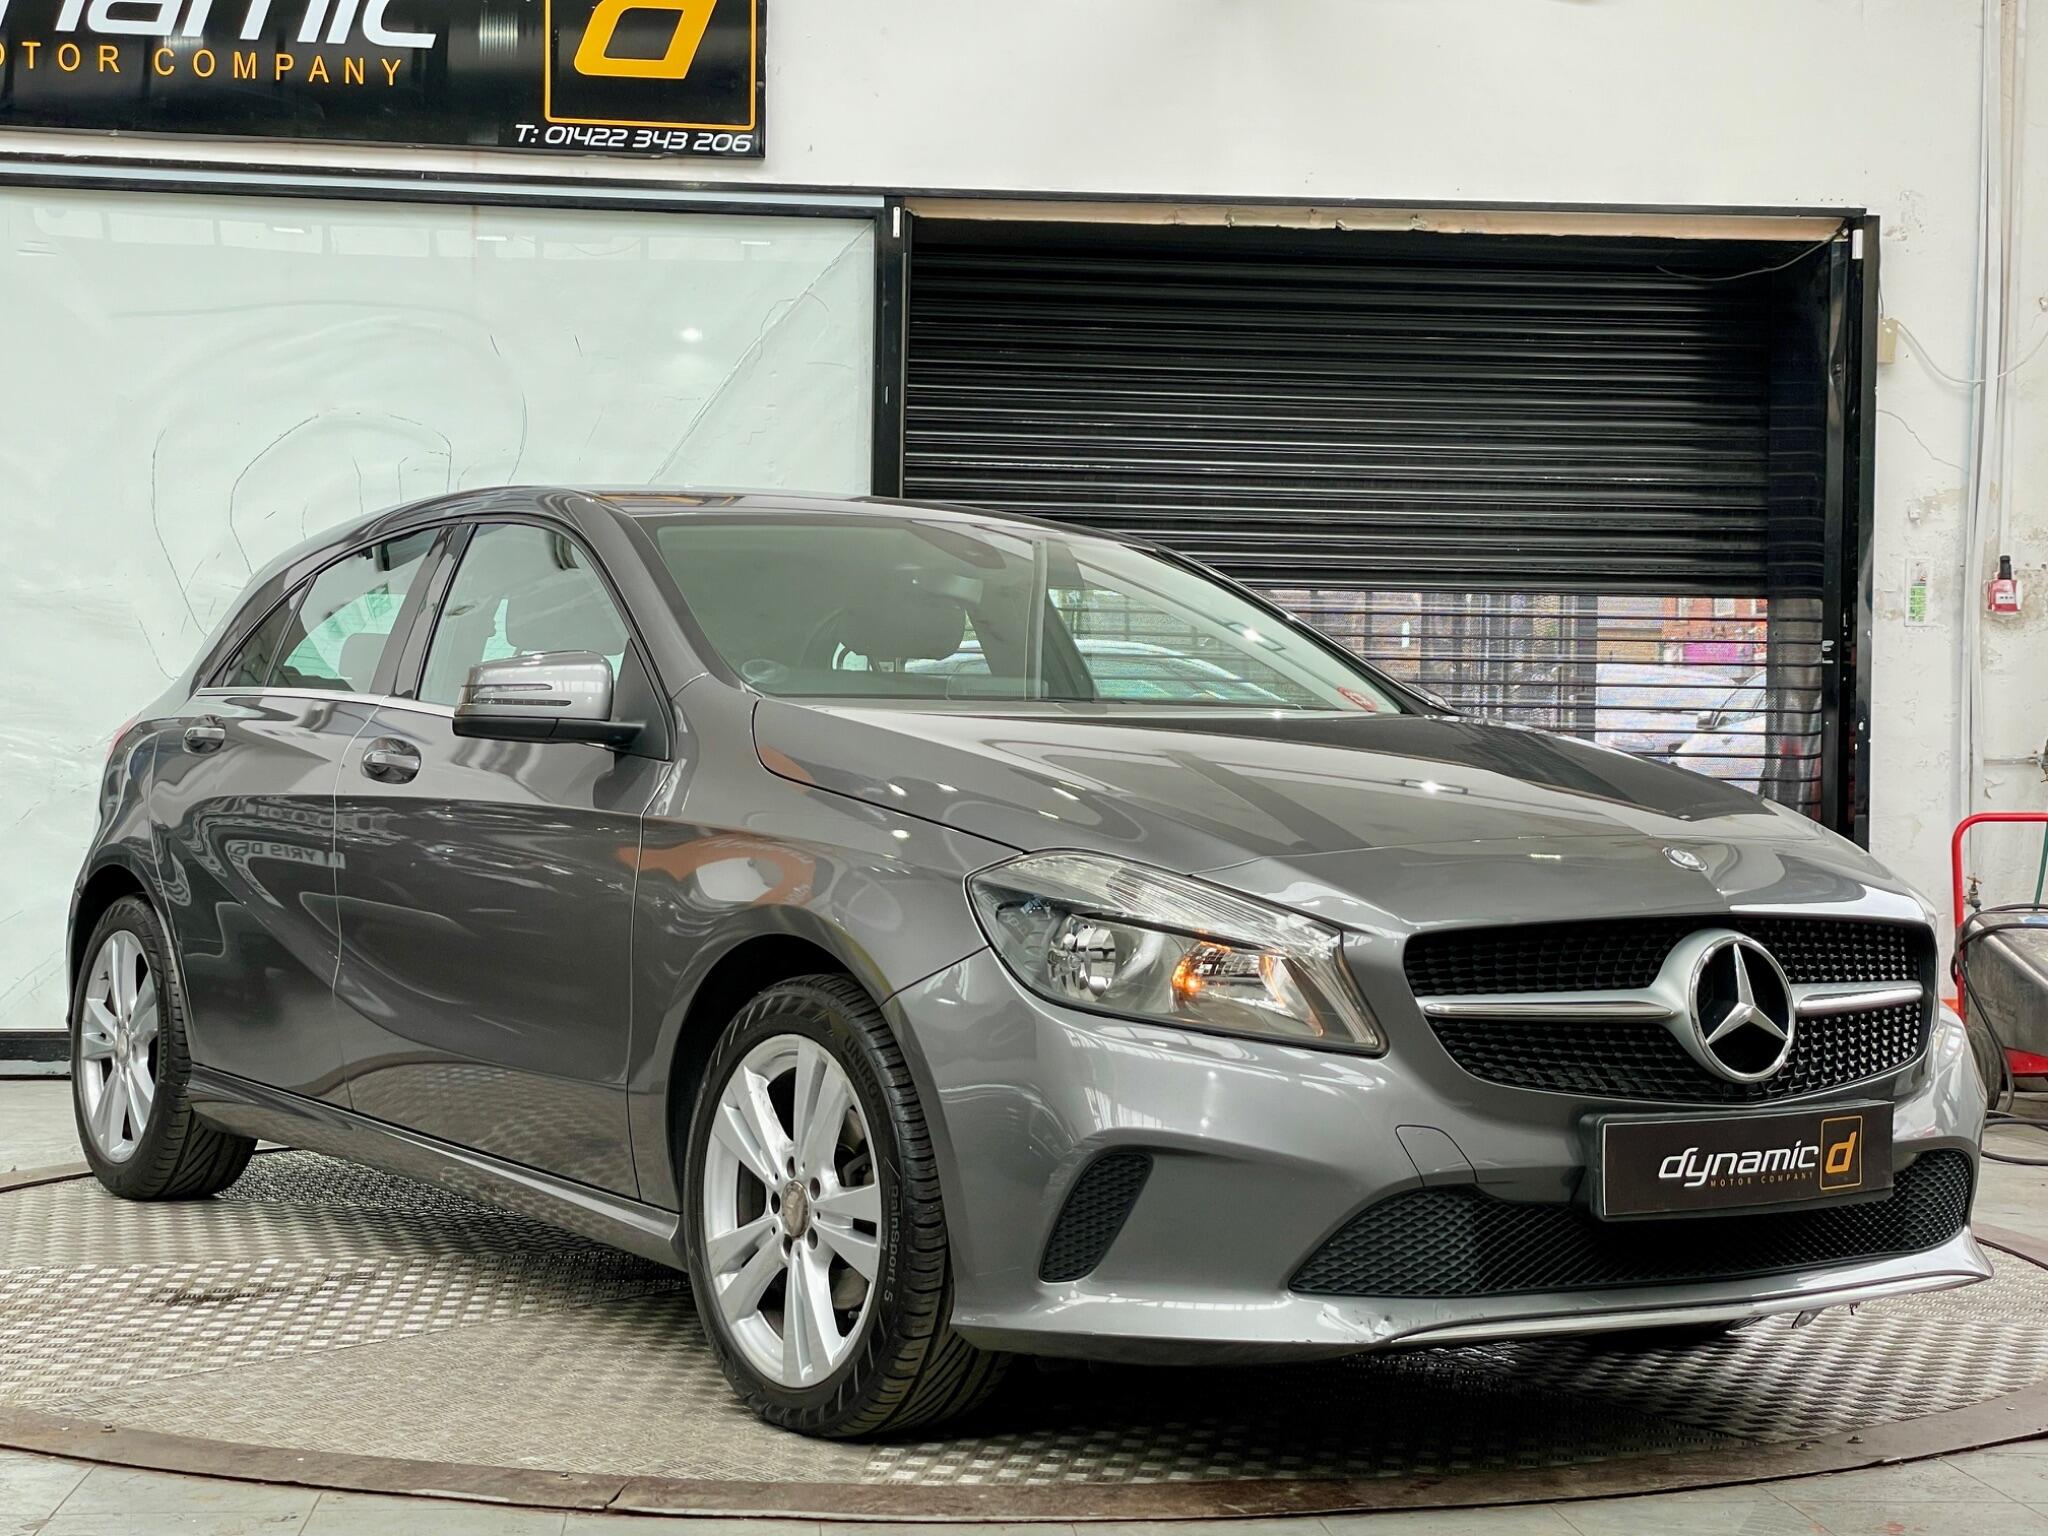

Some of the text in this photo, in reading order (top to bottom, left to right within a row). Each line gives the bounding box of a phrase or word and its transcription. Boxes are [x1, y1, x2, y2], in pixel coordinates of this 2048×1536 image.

[0, 41, 402, 86] TOR COMPANY
[515, 124, 754, 153] T: 01422 343 206
[1658, 1140, 1819, 1187] dynamic
[1710, 1171, 1814, 1188] MOTOR COMPANY
[883, 1184, 901, 1303] RainSport 5
